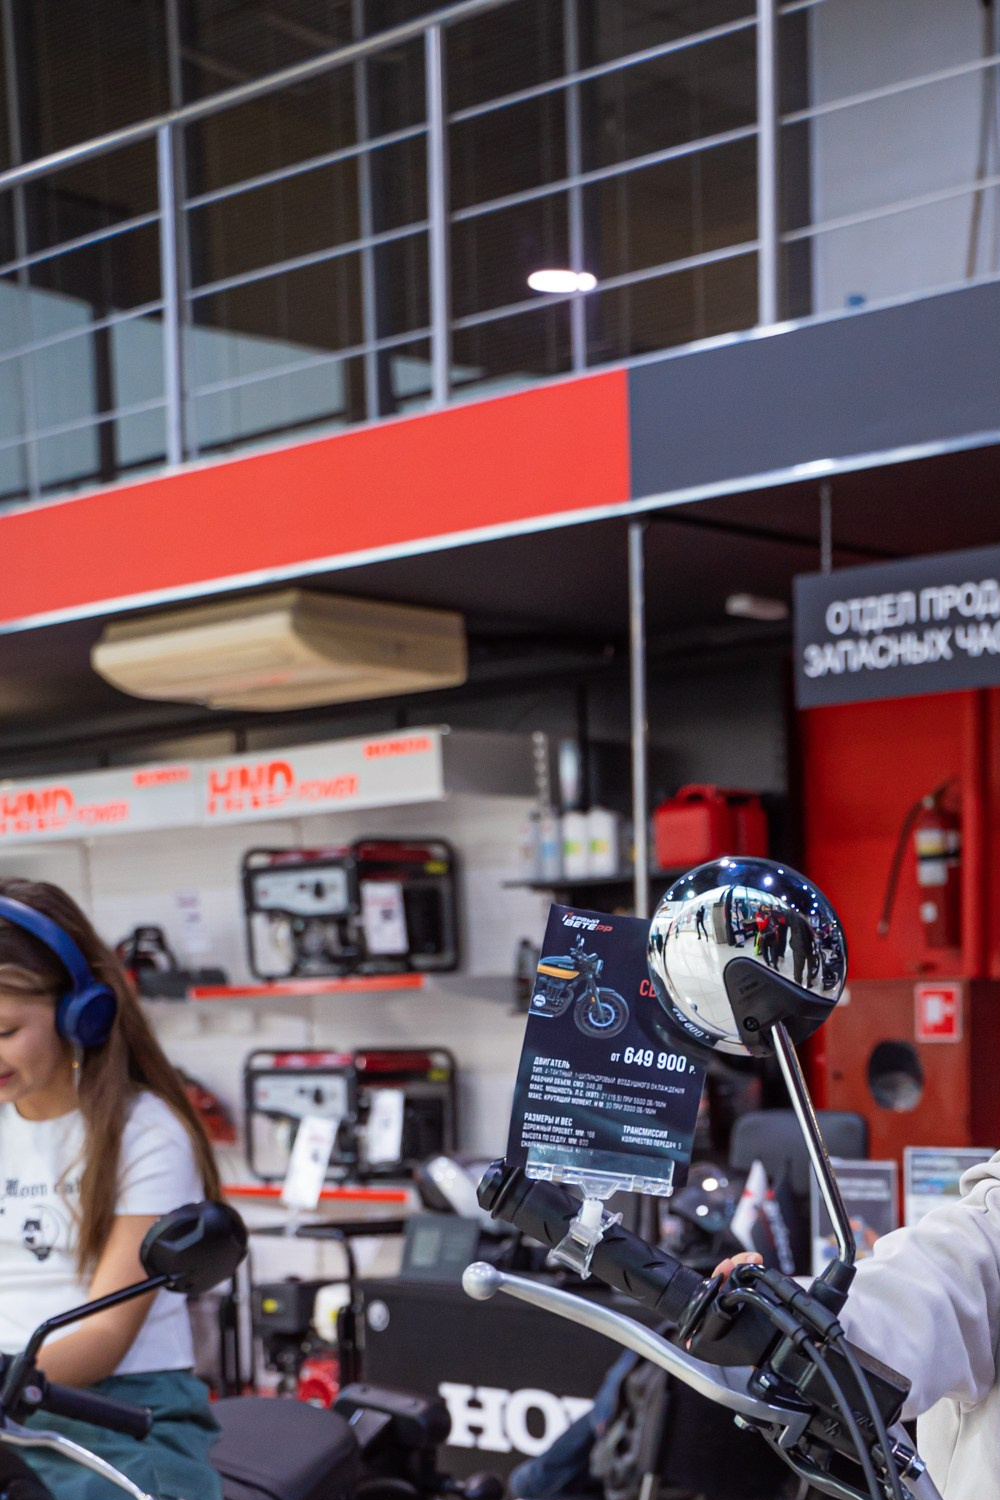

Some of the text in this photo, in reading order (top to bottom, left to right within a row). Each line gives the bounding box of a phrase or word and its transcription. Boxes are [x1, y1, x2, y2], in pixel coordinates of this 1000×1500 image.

[825, 590, 917, 635] ОТДЕЛ
[803, 626, 953, 678] ЗАПАСНЫХ
[533, 1056, 570, 1069] ДВИГАТЕЛЬ
[623, 1046, 653, 1069] 649
[656, 1051, 687, 1073] 900
[523, 1112, 573, 1127] РАЗМЕРЫ И ВЕС
[521, 1131, 542, 1140] ВЫСОТА
[623, 1124, 668, 1139] ТРАНСМИССИЯ
[621, 1135, 653, 1146] КОЛИЧЕСТВО
